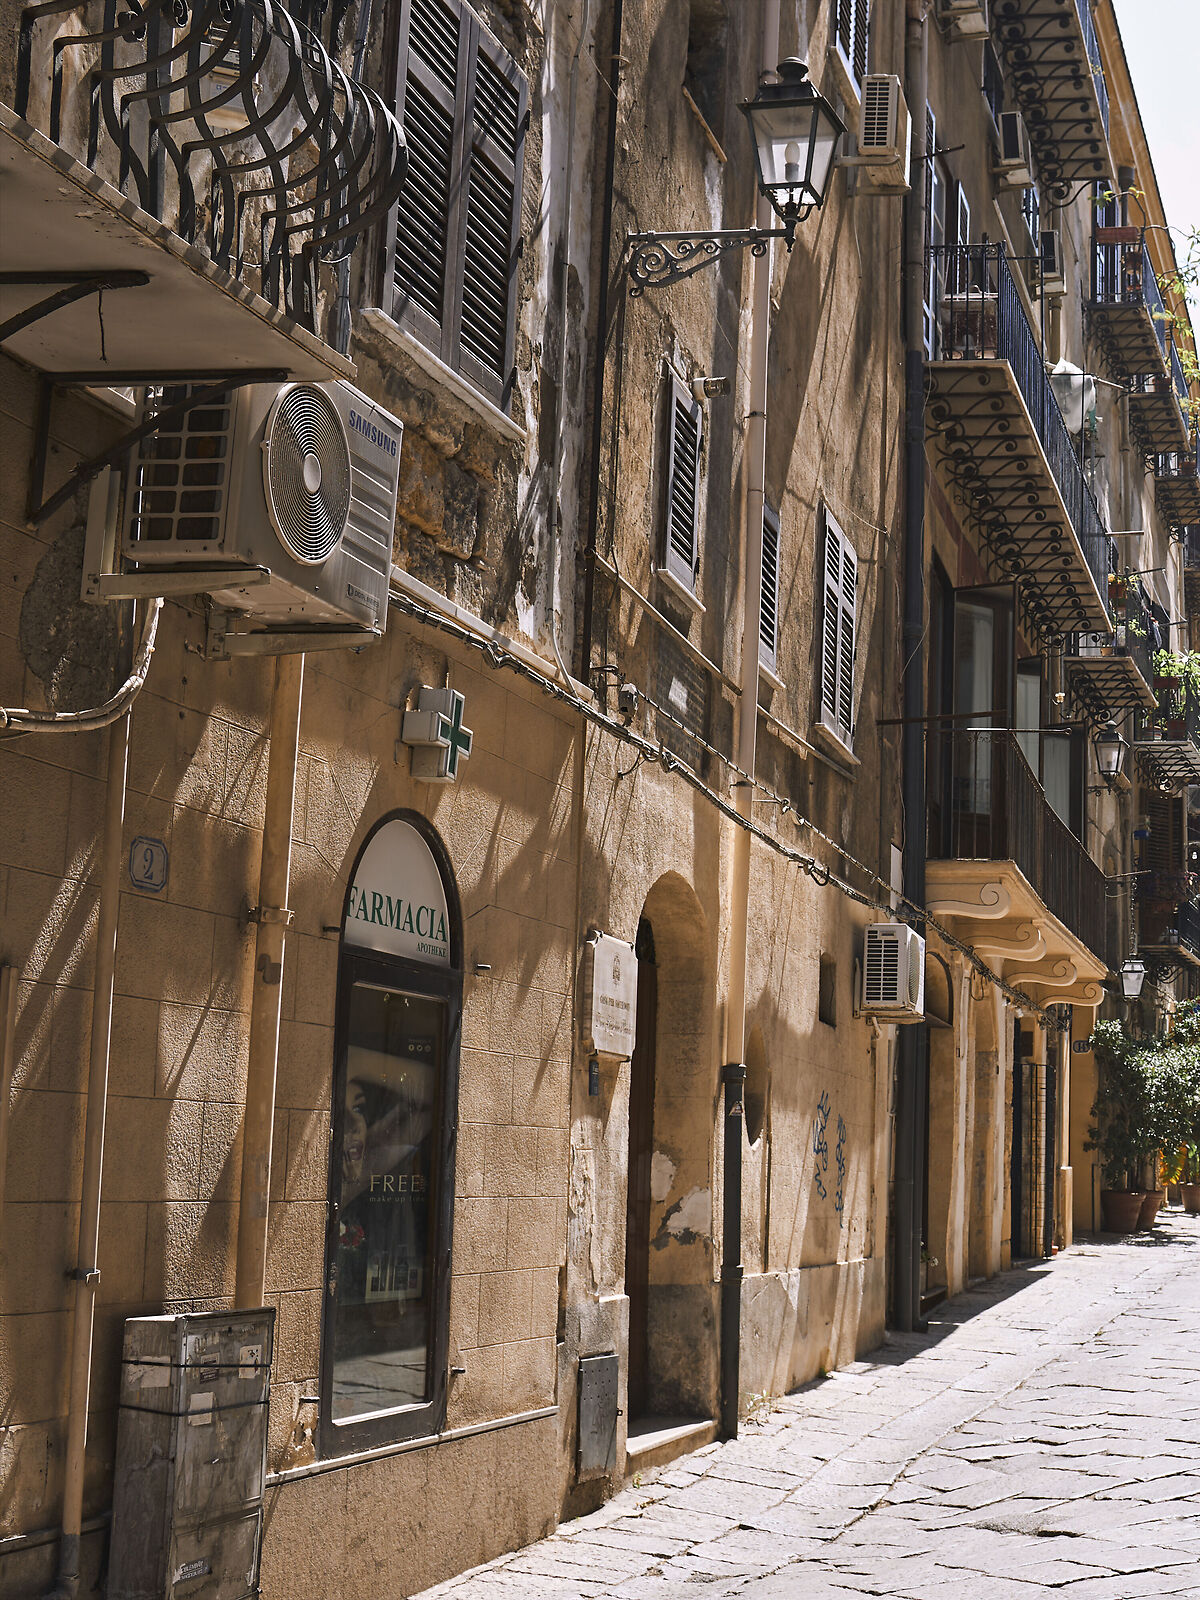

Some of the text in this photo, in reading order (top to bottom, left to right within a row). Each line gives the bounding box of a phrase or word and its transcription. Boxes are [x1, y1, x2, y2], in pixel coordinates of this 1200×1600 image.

[349, 410, 397, 457] SAMSUNG
[143, 847, 154, 881] 2
[347, 885, 447, 943] FARMACIA
[416, 942, 447, 958] APOTHEKE
[370, 1174, 421, 1193] FREE
